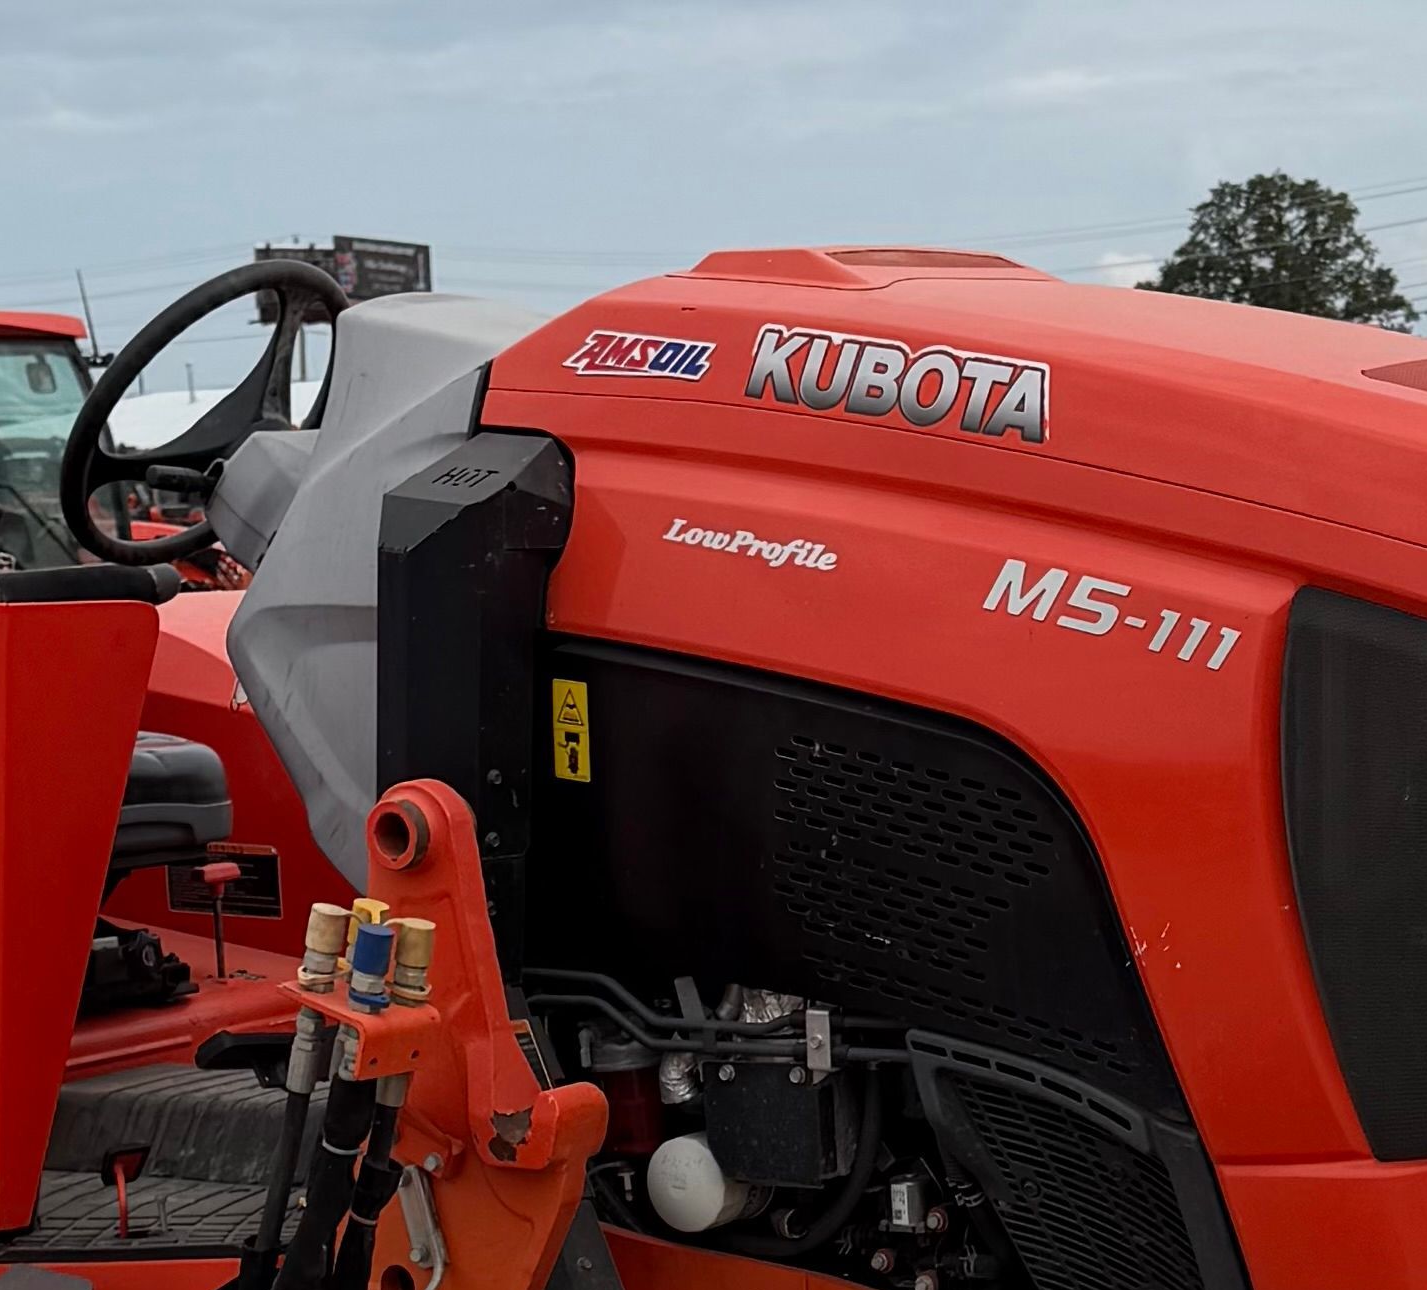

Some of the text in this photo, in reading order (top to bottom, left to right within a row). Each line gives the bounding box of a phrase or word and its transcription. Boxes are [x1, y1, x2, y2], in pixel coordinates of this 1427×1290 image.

[570, 332, 712, 377] AMSOIL
[744, 325, 1049, 443] KUBOTA
[431, 467, 500, 487] HOT
[662, 518, 839, 571] LowProfile
[982, 558, 1242, 671] M5-111
